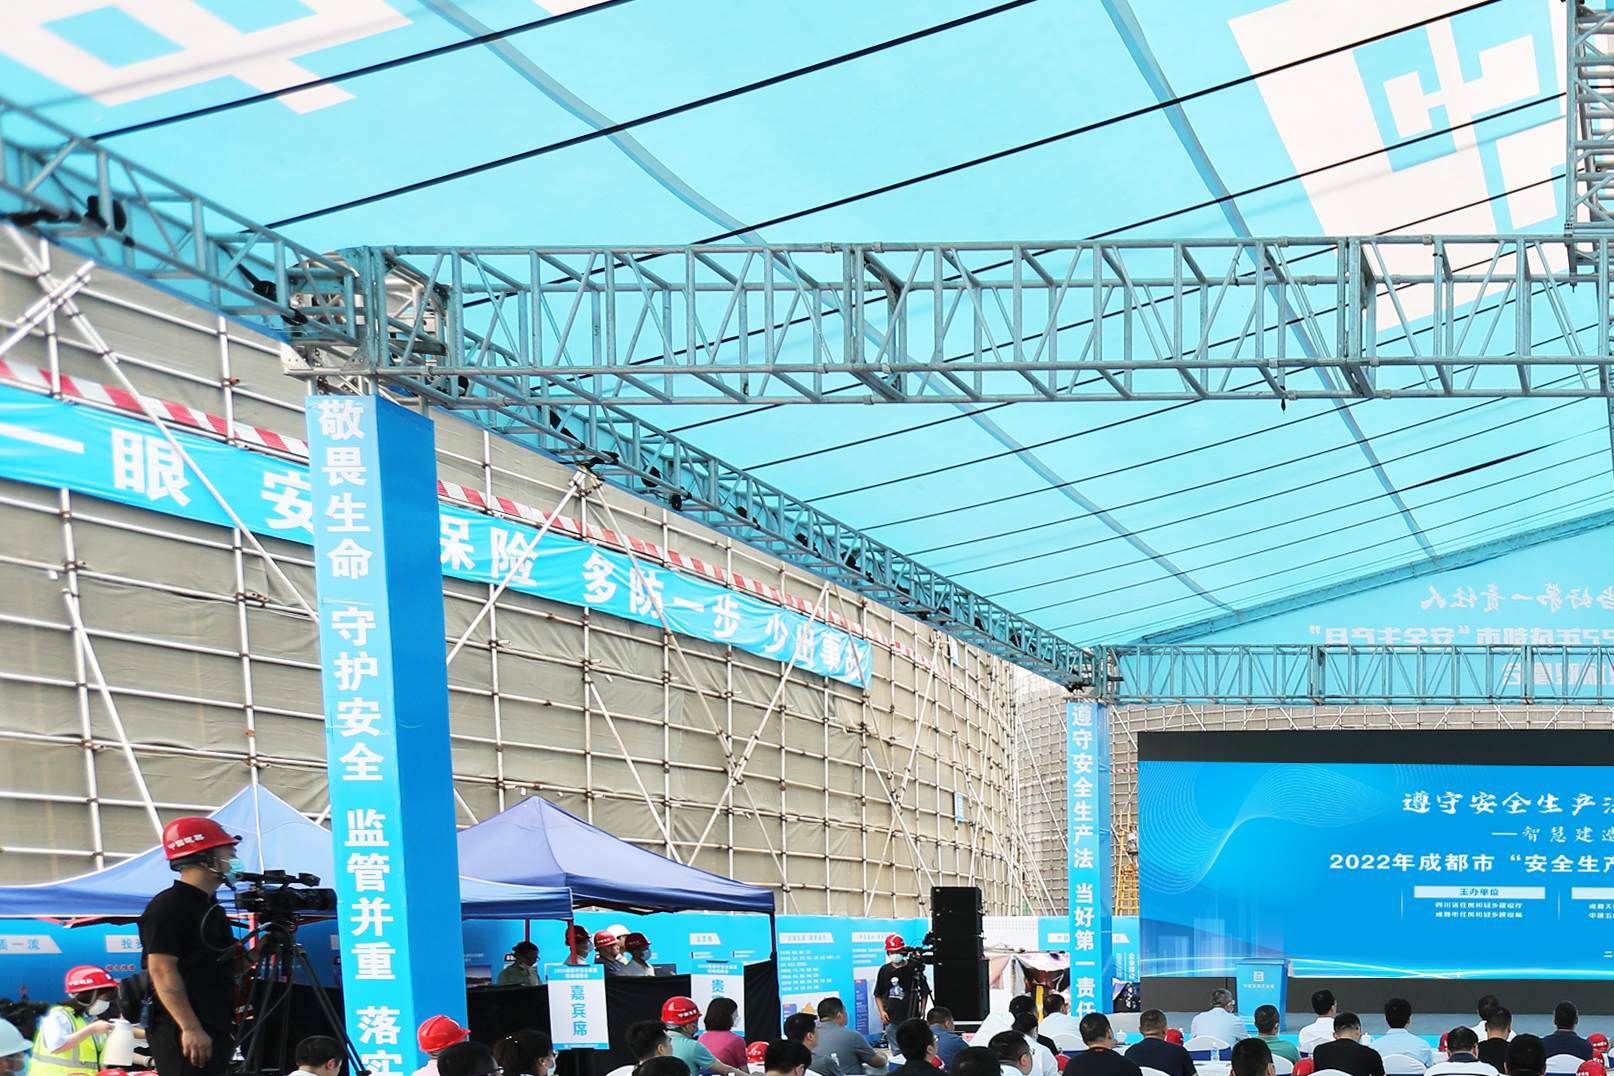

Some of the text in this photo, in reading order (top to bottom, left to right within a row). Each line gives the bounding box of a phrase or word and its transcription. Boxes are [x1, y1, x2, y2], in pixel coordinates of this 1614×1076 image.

[318, 399, 372, 580] 敬畏生命
[581, 551, 742, 638] 多防一步
[330, 605, 383, 780] 守护安全
[1072, 705, 1094, 869] 遵守安全生产法
[345, 808, 396, 980] 监管并重
[1459, 888, 1499, 896] 主办单位
[570, 985, 587, 1036] 嘉宾席
